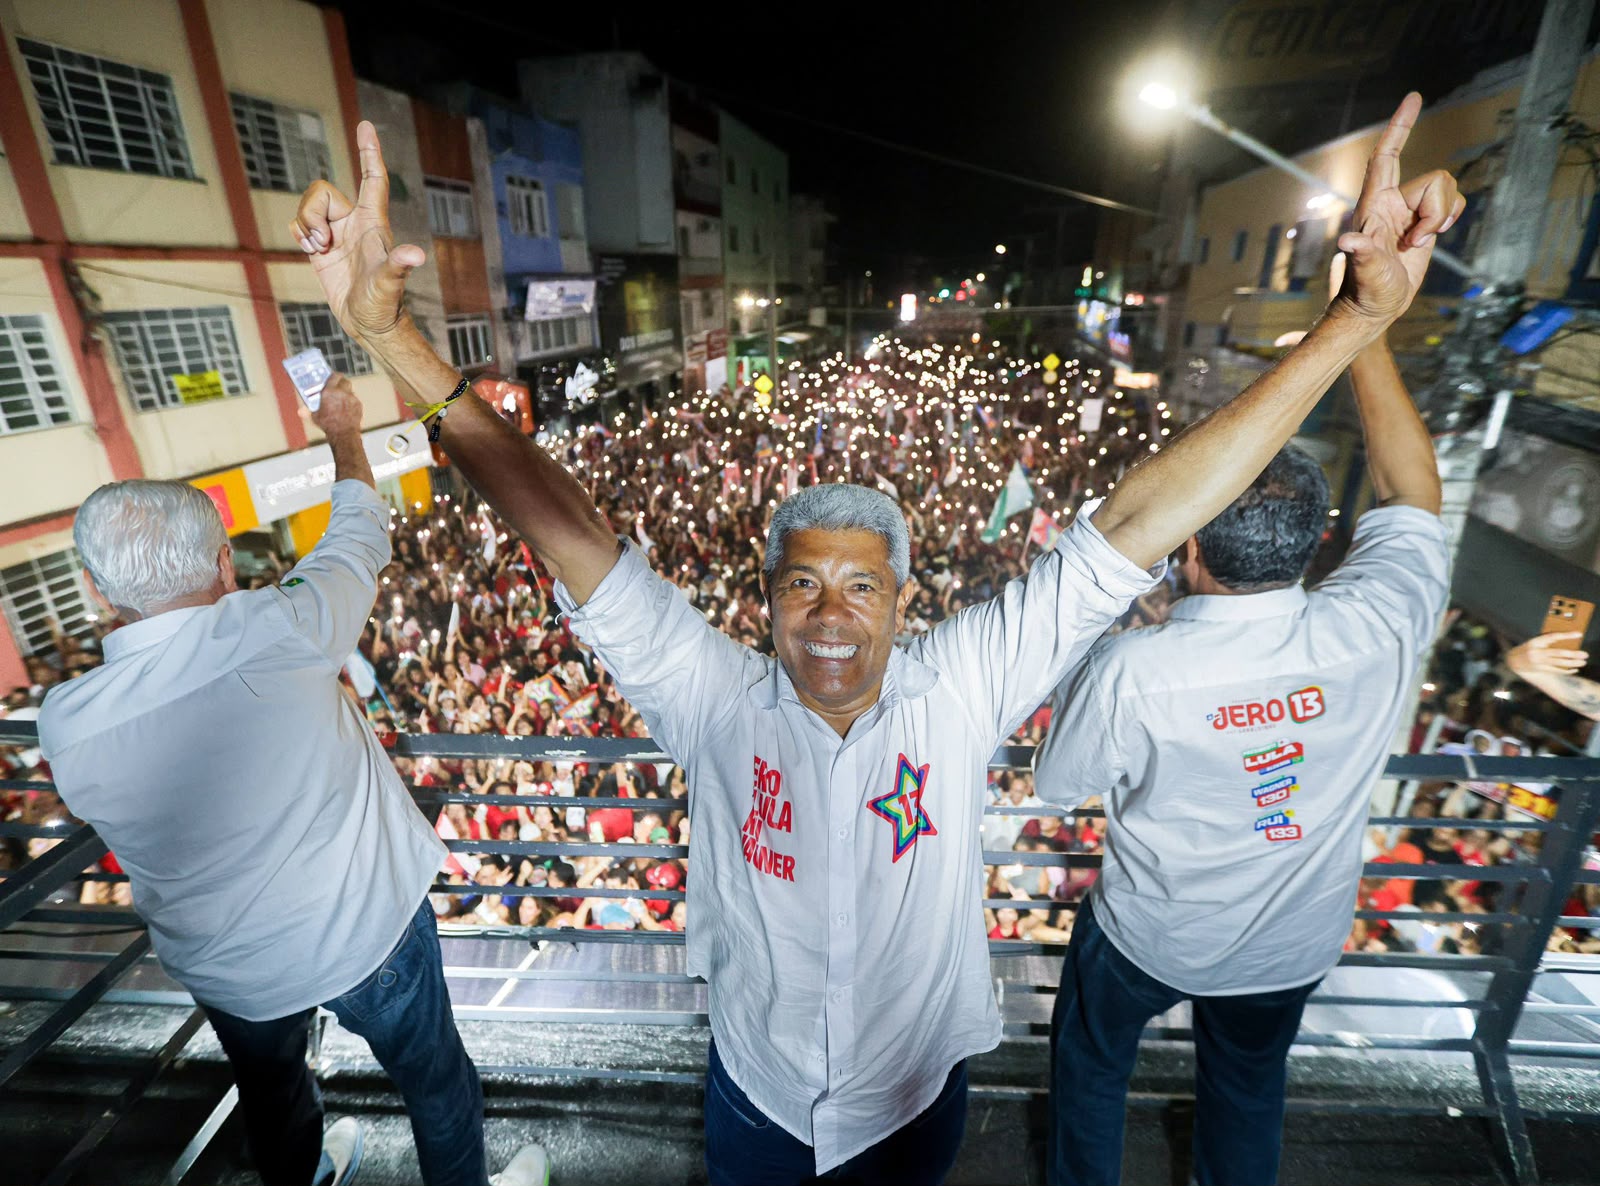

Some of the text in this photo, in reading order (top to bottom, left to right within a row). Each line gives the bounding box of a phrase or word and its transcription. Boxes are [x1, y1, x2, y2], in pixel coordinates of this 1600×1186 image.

[1213, 699, 1285, 730] JERO
[1291, 691, 1322, 719] 13
[1245, 744, 1298, 768] LULA
[1253, 778, 1293, 796] WAGNER
[1260, 789, 1287, 805] 130
[752, 788, 792, 833] ULA
[1257, 814, 1284, 829] RUI
[1268, 827, 1299, 840] 133
